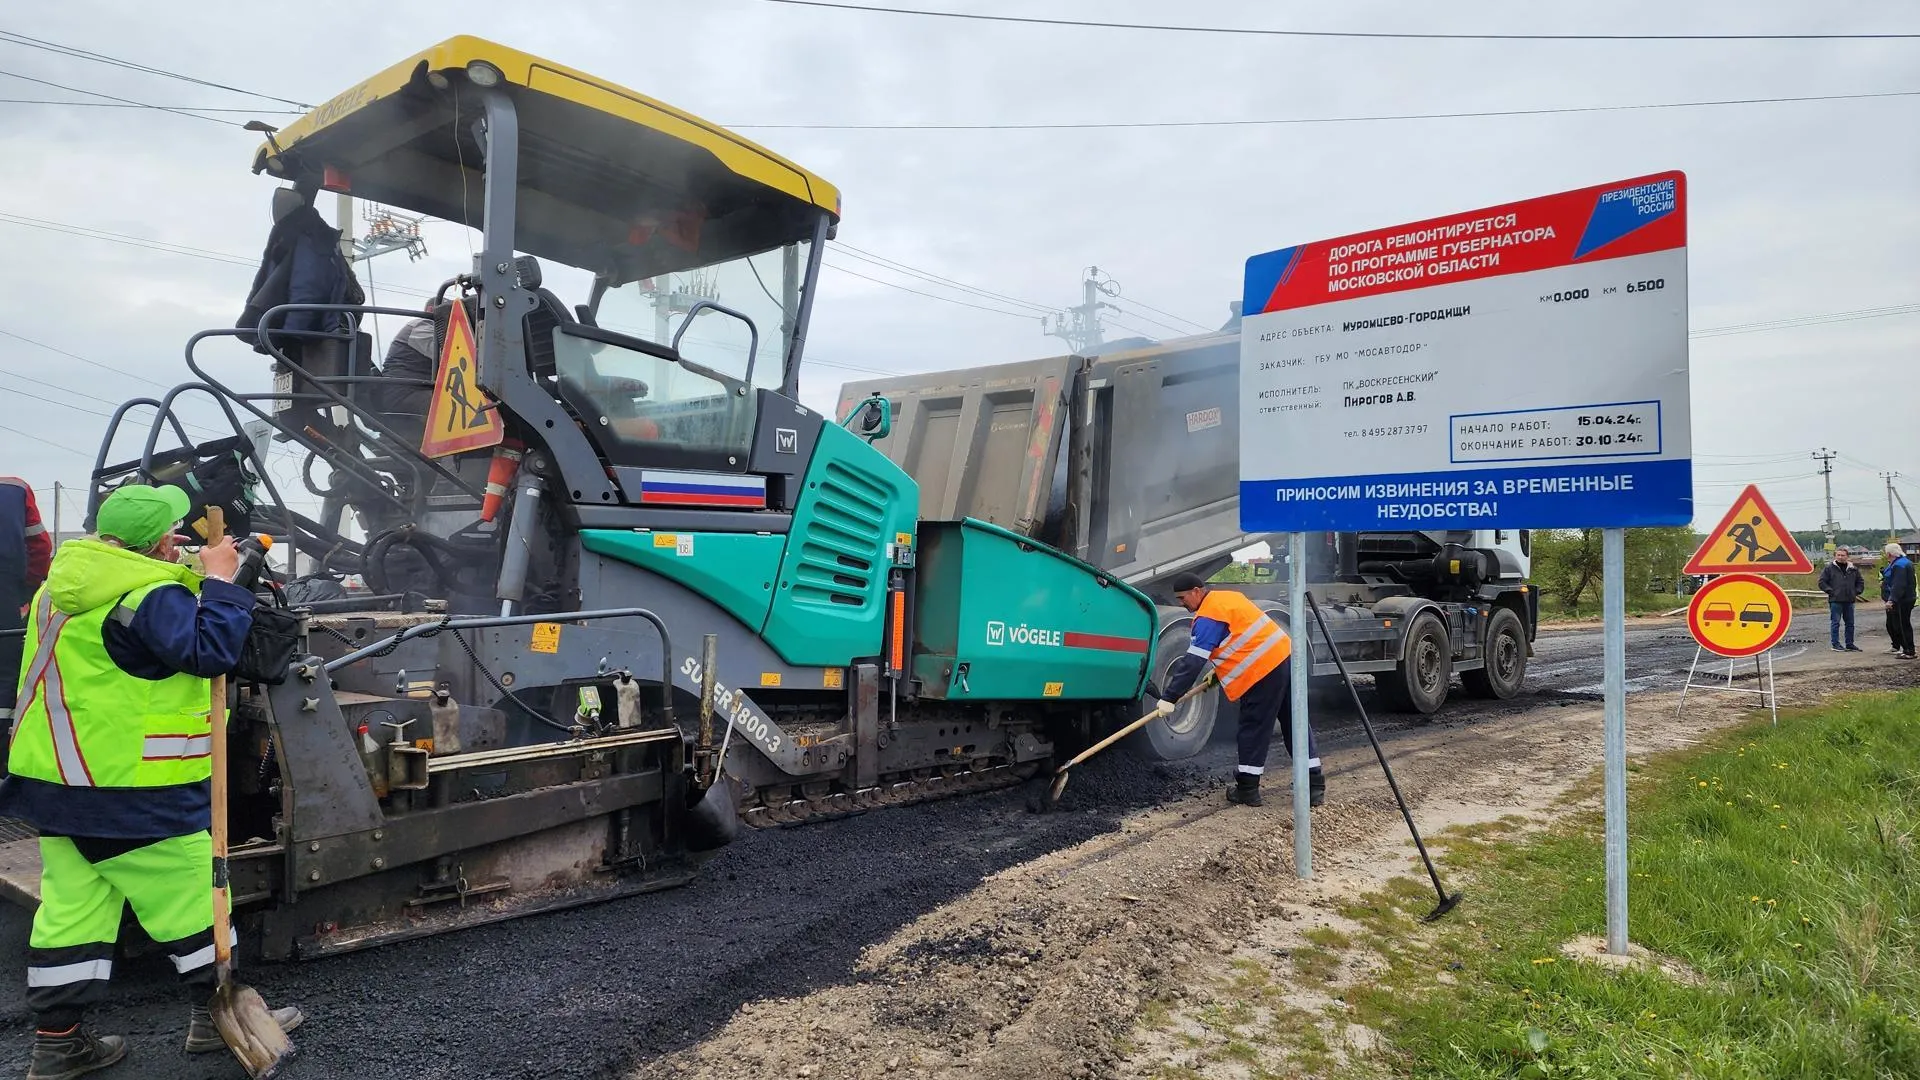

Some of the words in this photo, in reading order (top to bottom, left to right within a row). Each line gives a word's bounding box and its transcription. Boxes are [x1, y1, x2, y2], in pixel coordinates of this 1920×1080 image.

[1602, 180, 1674, 203] ПРЕЗИДЕНТСКИЕ
[1632, 191, 1675, 207] ПРОЕКТЫ
[1638, 201, 1675, 216] РОССИИ
[1328, 240, 1382, 263] ДОРОГА
[1386, 213, 1517, 250] РЕМОНТИРУЕТСЯ
[1329, 260, 1347, 277] ПО
[1351, 245, 1438, 274] ПРОГРАММЕ
[1442, 225, 1556, 256] ГУБЕРНАТОРА
[1328, 263, 1424, 293] МОСКОВСКОЙ
[1428, 253, 1500, 276] ОБЛАСТИ
[1553, 288, 1590, 303] 0.000
[1626, 278, 1665, 293] 6.500
[1260, 331, 1287, 342] АДРЕС
[1292, 324, 1334, 337] ОБЪЕКТА:
[1260, 358, 1305, 371] ЗАКАЗЧИК:
[1315, 354, 1331, 364] ГБУ
[1336, 351, 1349, 361] МО
[1259, 385, 1321, 399] ИСПОЛНИТЕЛЬ:
[1259, 401, 1322, 414] ответственный:
[1396, 391, 1417, 403] А.В.
[1460, 423, 1504, 435] НАЧАЛО
[1511, 420, 1551, 431] РАБОТ:
[1460, 439, 1524, 451] ОКОНЧАНИЕ
[1531, 436, 1572, 448] РАБОТ:
[1276, 484, 1361, 502] ПРИНОСИМ
[1364, 481, 1469, 499] ИЗВИНЕНИЯ
[1473, 478, 1499, 496] ЗА
[1503, 474, 1634, 495] ВРЕМЕННЫЕ
[1377, 502, 1498, 520] НЕУДОБСТВА!
[1008, 623, 1061, 647] VÖGELE
[680, 657, 734, 710] SUER
